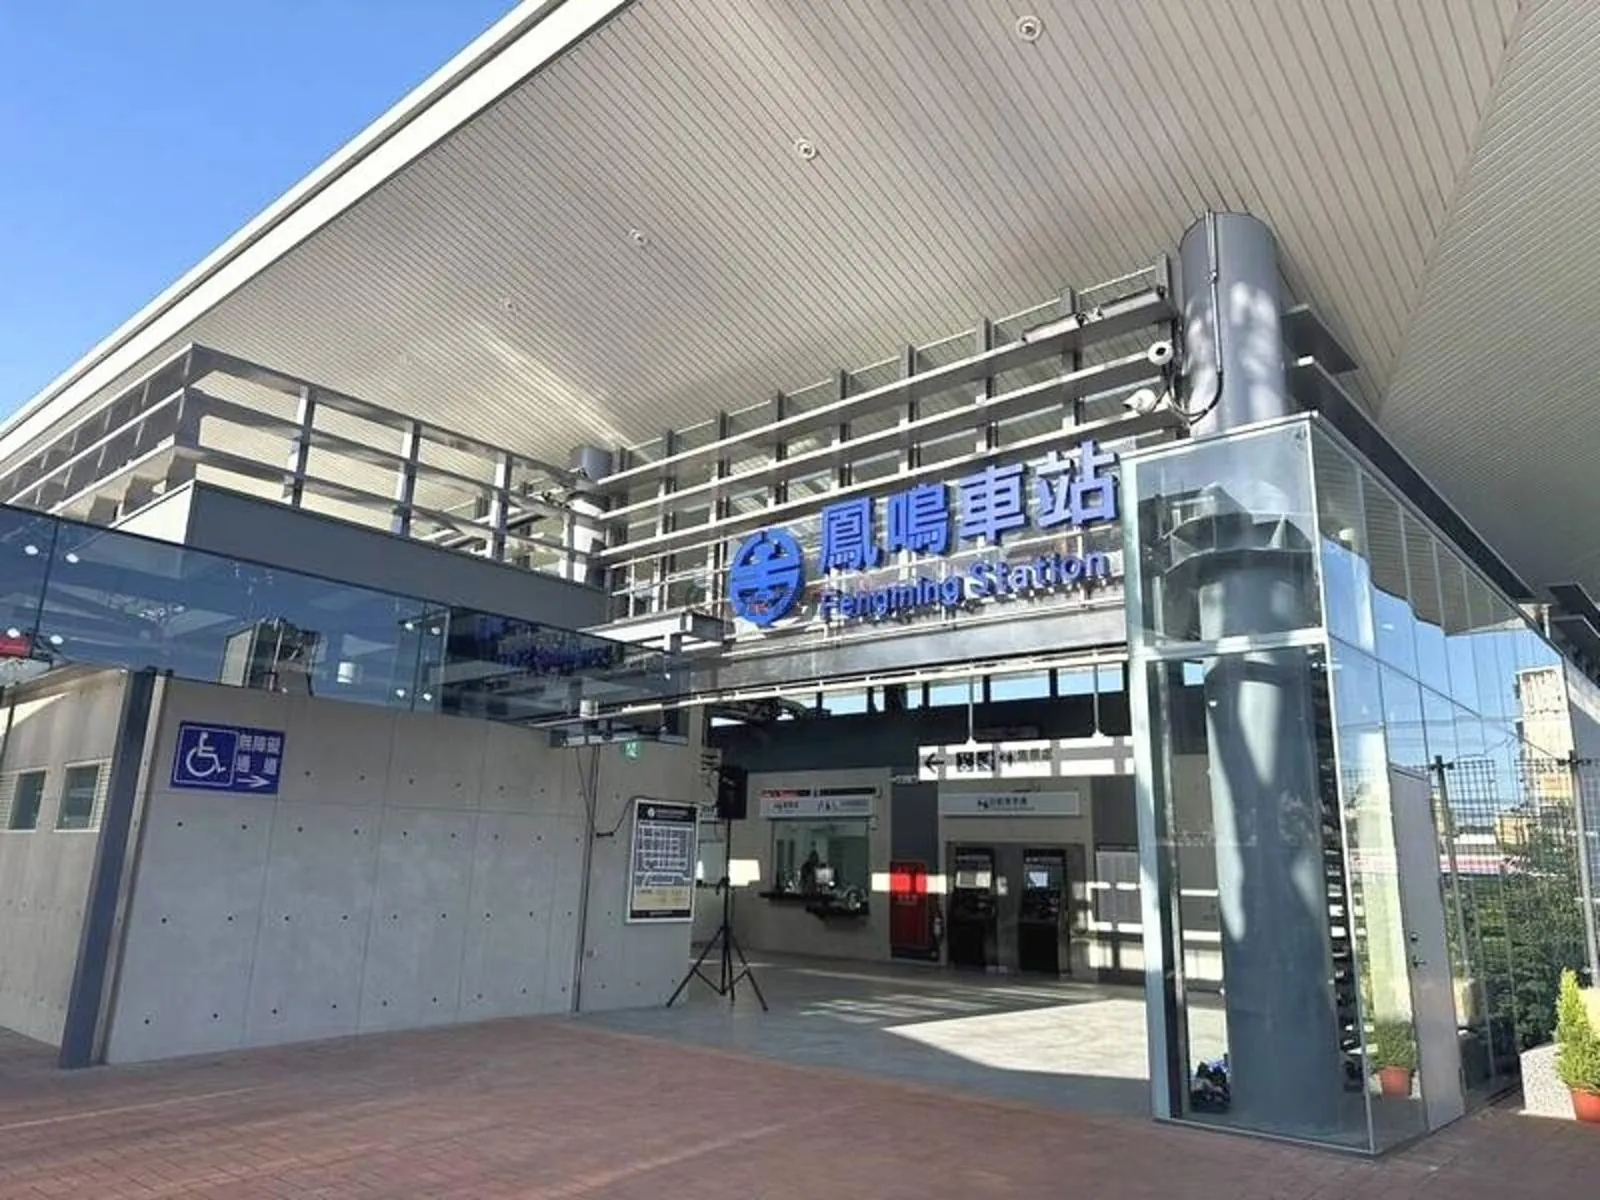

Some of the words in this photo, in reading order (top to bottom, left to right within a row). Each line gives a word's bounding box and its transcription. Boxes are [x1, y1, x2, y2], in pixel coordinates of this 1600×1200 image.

[820, 440, 1117, 573] 鳳鳴車站
[820, 576, 962, 619] Fengming
[968, 551, 1108, 596] Station
